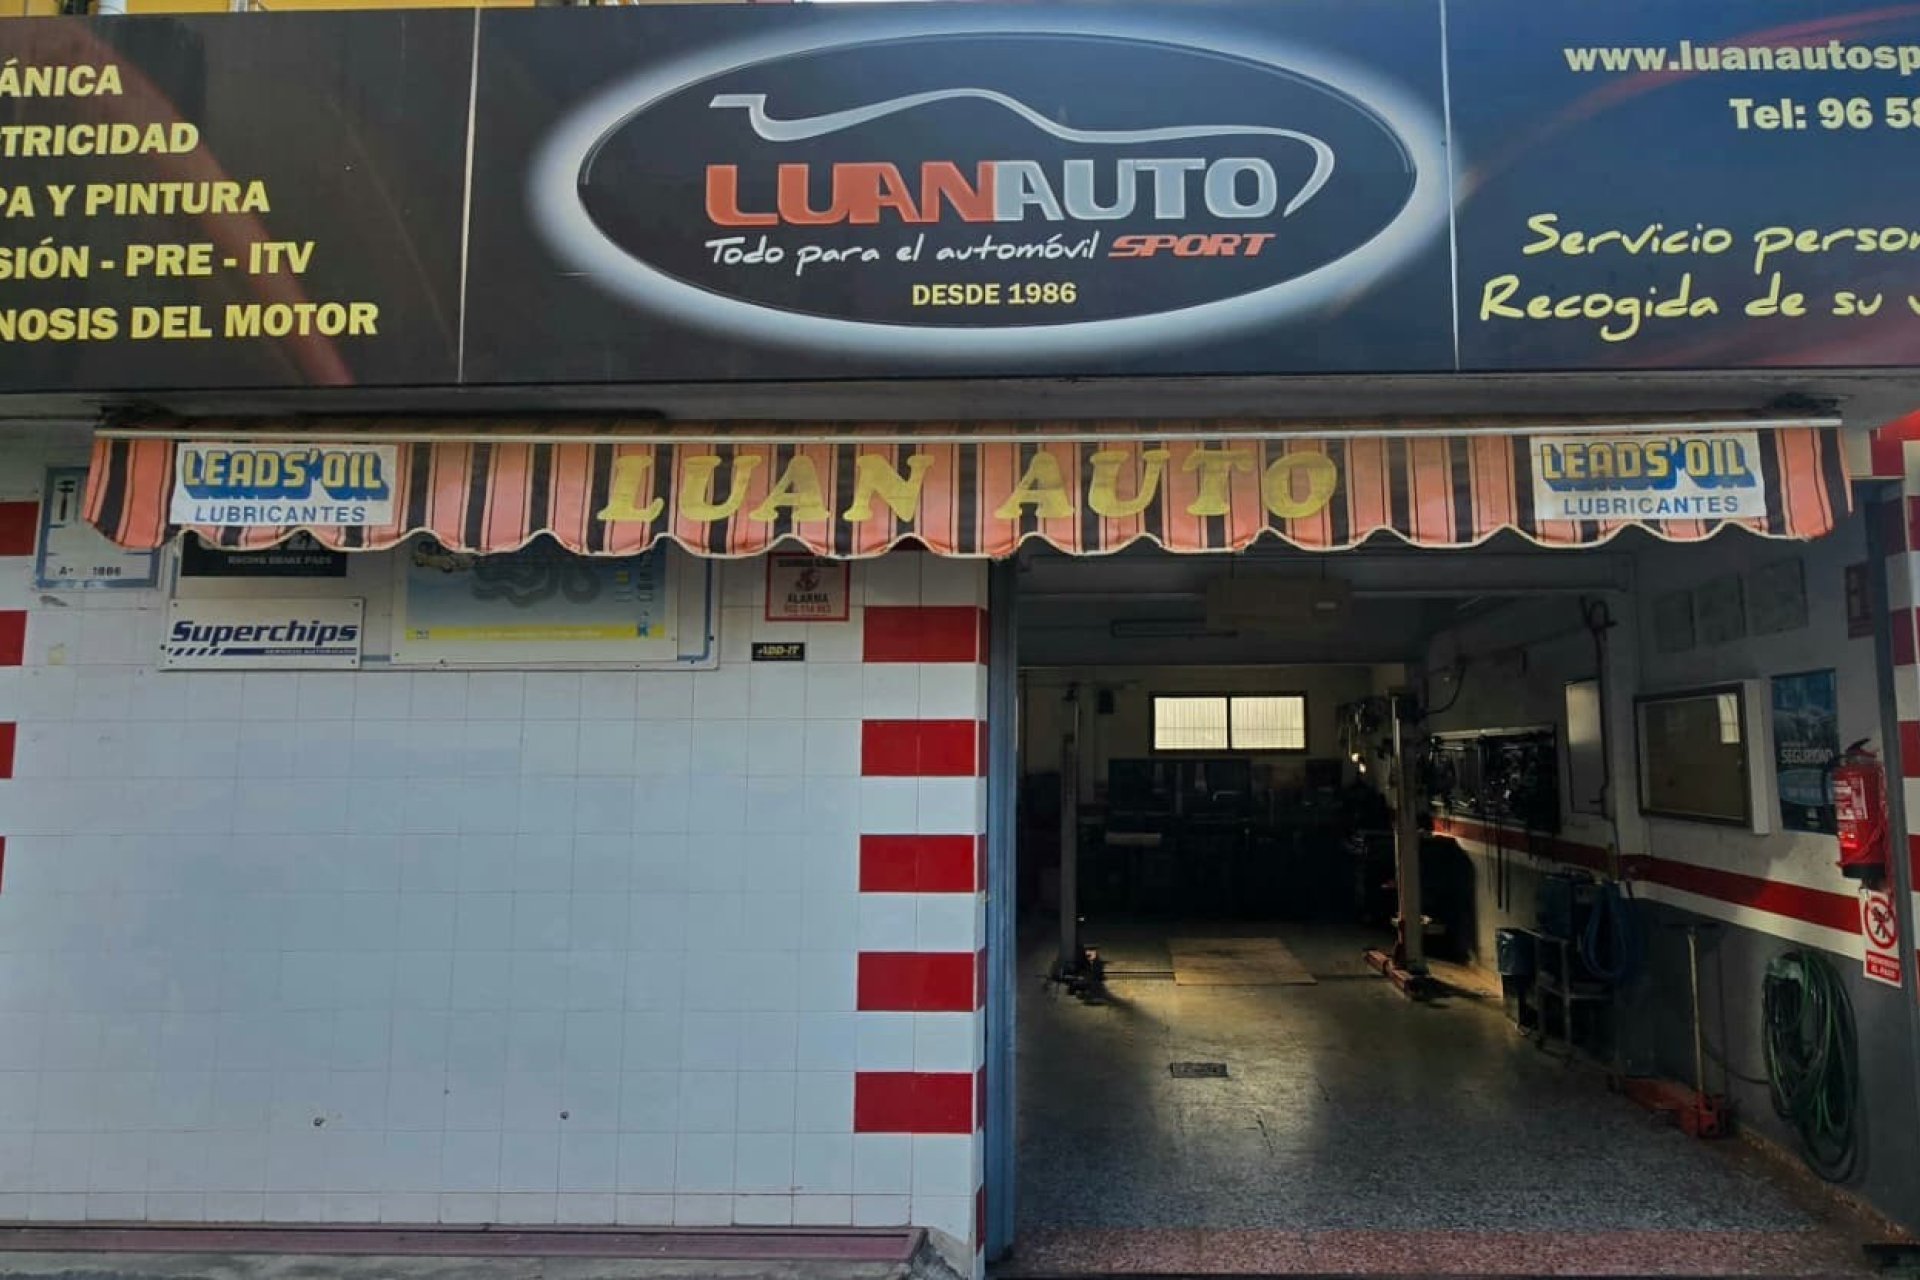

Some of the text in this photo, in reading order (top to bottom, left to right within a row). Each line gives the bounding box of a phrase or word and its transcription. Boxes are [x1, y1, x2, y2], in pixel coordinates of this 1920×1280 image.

[1564, 40, 1920, 76] www.luanautosp
[1729, 98, 1807, 129] Tel:
[1818, 97, 1873, 129] 96
[47, 184, 75, 217] Y
[84, 180, 270, 215] PINTURA
[705, 157, 1279, 226] LUANAUTO
[1108, 232, 1277, 258] SPORT
[1522, 213, 1732, 255] Servicio
[126, 243, 213, 277] PRE
[248, 240, 315, 275] ITV
[705, 230, 1099, 277] Todo para el automóvil
[911, 283, 1077, 306] DESDE 1986
[1480, 272, 1719, 342] Recogida
[1744, 271, 1806, 317] de
[1832, 291, 1883, 316] su
[130, 306, 213, 339] DEL
[224, 302, 379, 338] MOTOR
[597, 451, 1336, 520] LUAN AUTO
[194, 505, 367, 523] LUBRICANTES
[1563, 495, 1739, 516] LUBRICANTES
[170, 620, 358, 647] Superchips
